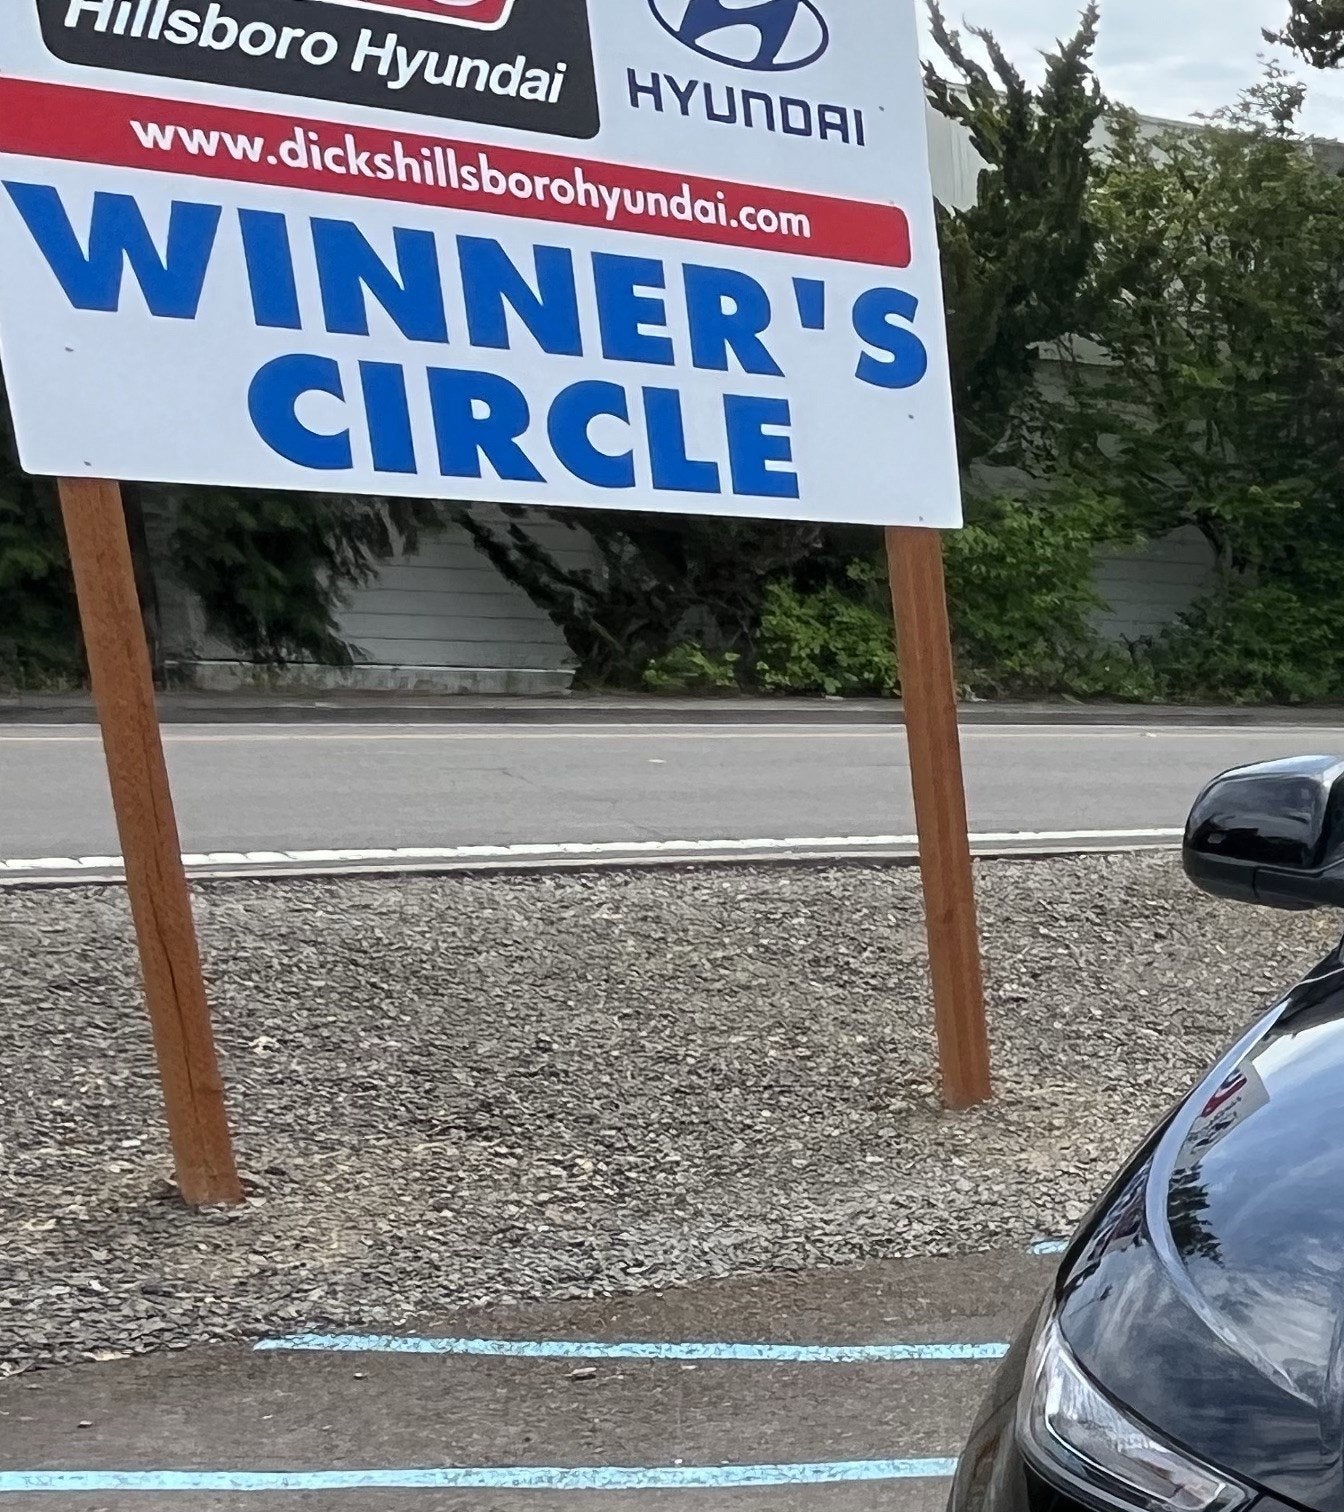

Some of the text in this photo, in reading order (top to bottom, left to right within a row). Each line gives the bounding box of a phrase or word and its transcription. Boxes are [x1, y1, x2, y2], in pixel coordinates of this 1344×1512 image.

[64, 0, 567, 103] Hillsboro Hyundai
[628, 67, 866, 147] HYUNDAI
[129, 115, 812, 239] www.dickshillsborohyundai.com
[0, 180, 929, 389] WINNER'S
[247, 353, 801, 499] CIRCLE
